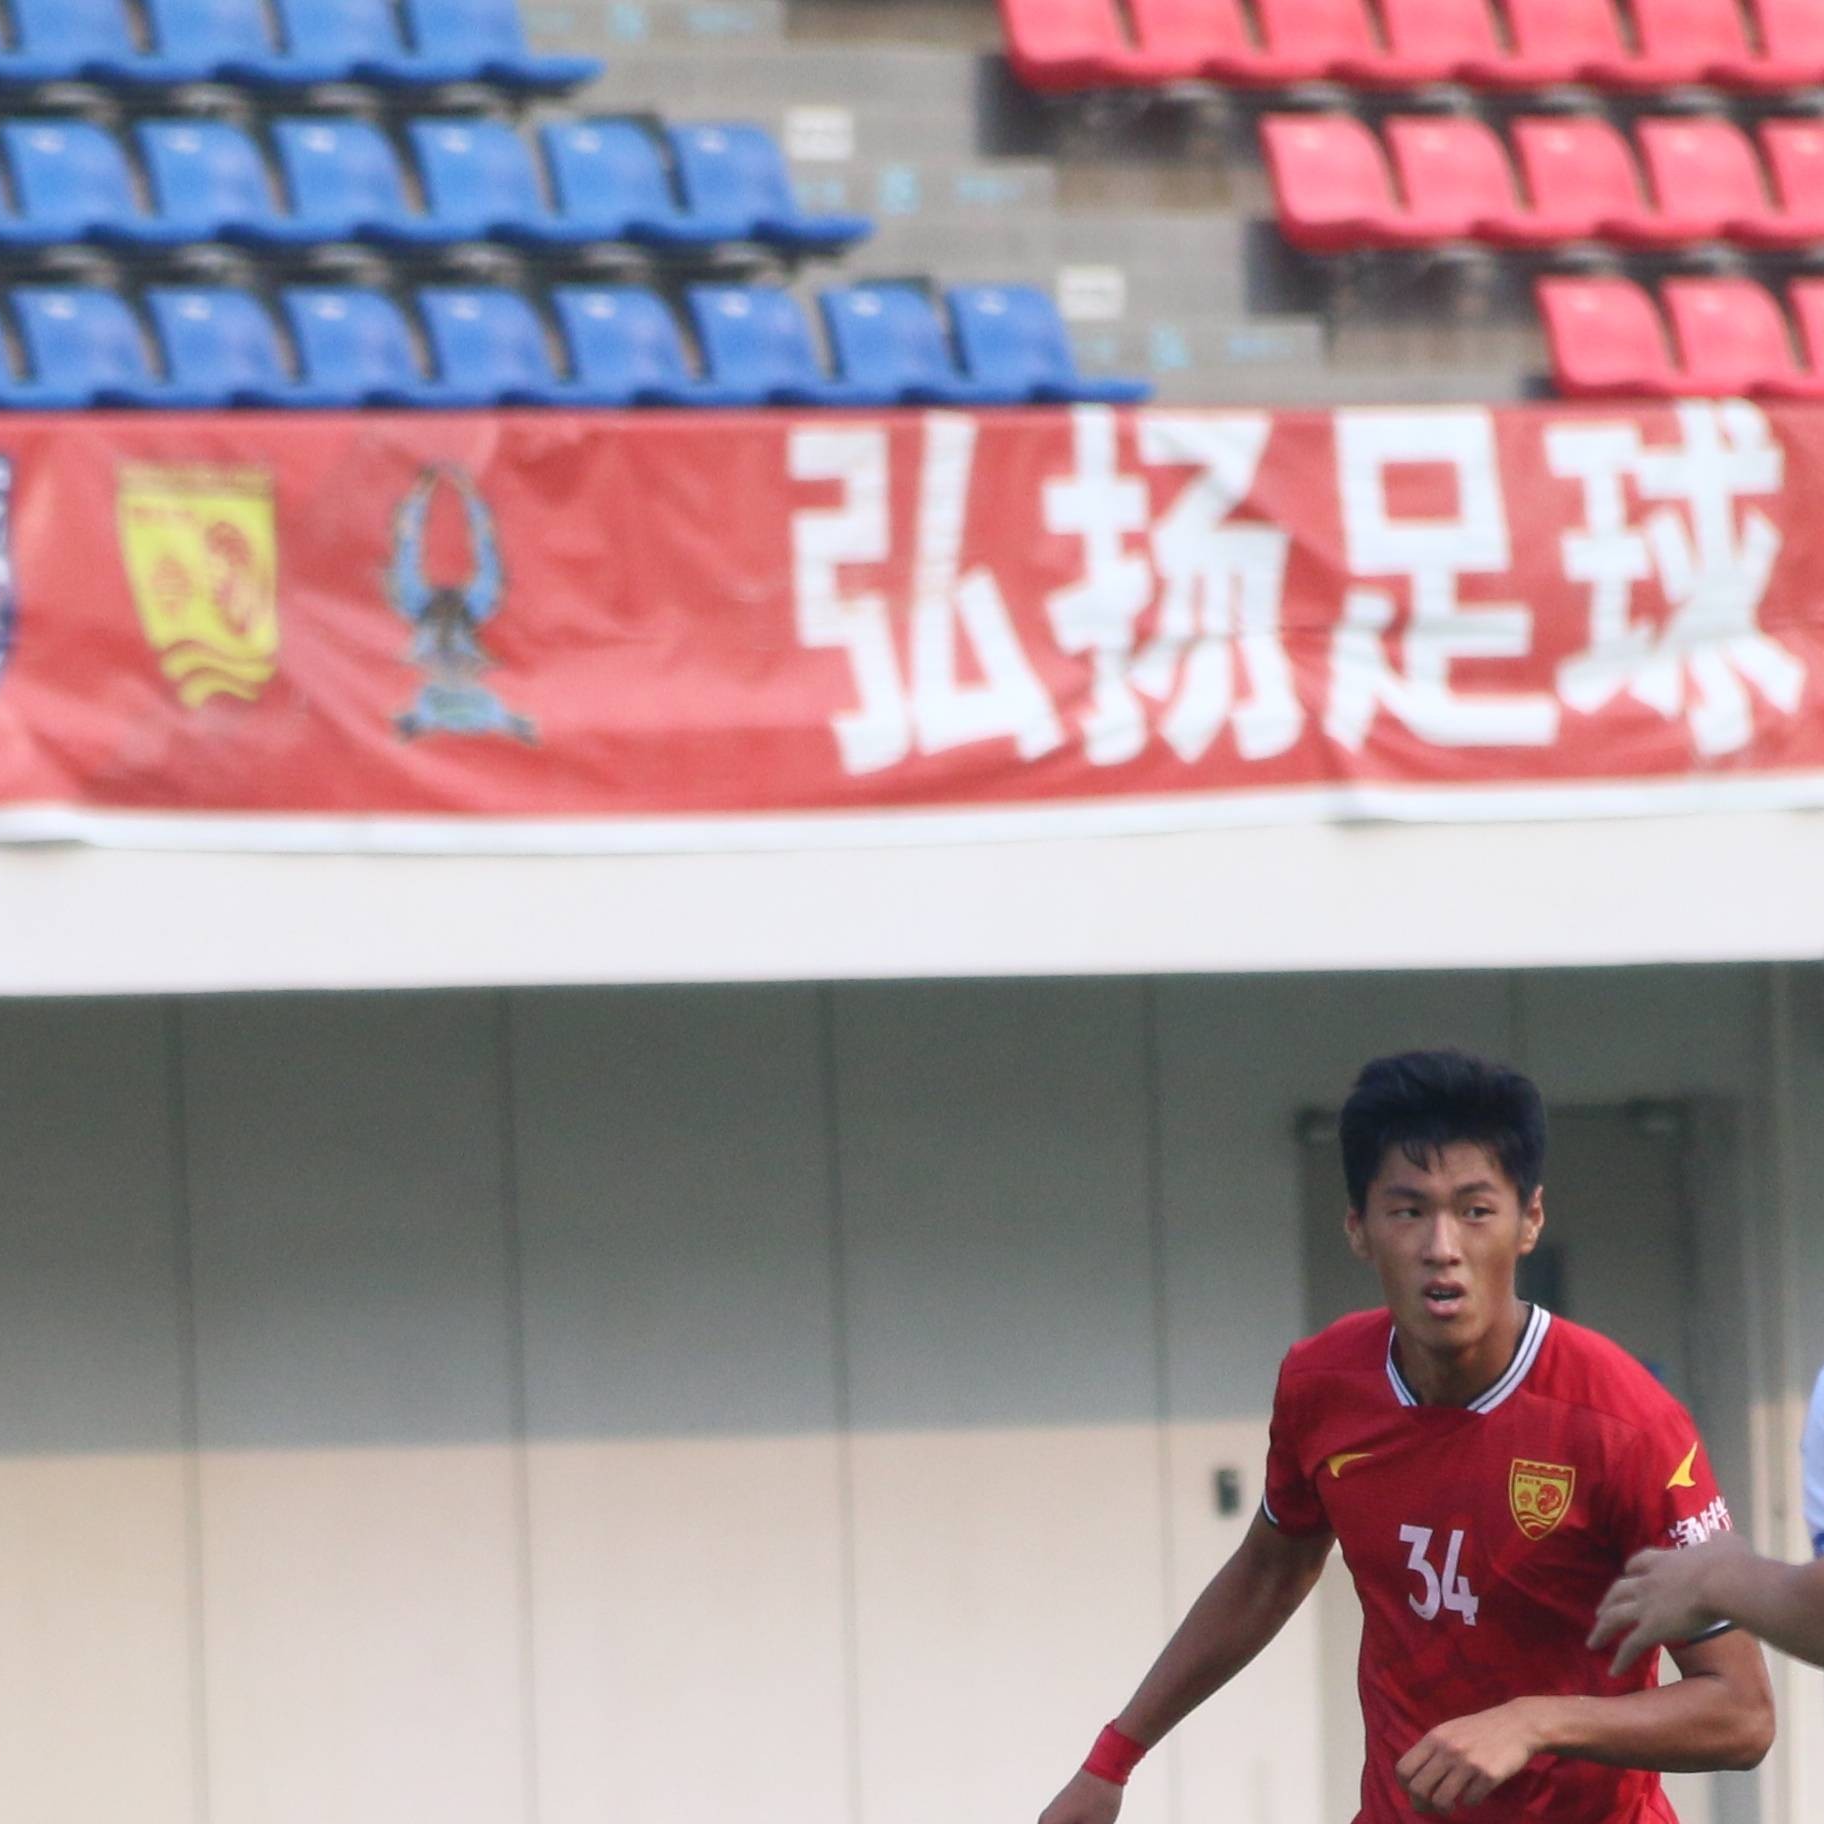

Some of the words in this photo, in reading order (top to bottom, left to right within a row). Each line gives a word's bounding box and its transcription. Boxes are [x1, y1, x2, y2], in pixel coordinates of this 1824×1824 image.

[788, 407, 1808, 770] 弘扬足球
[1399, 1524, 1479, 1627] 34
